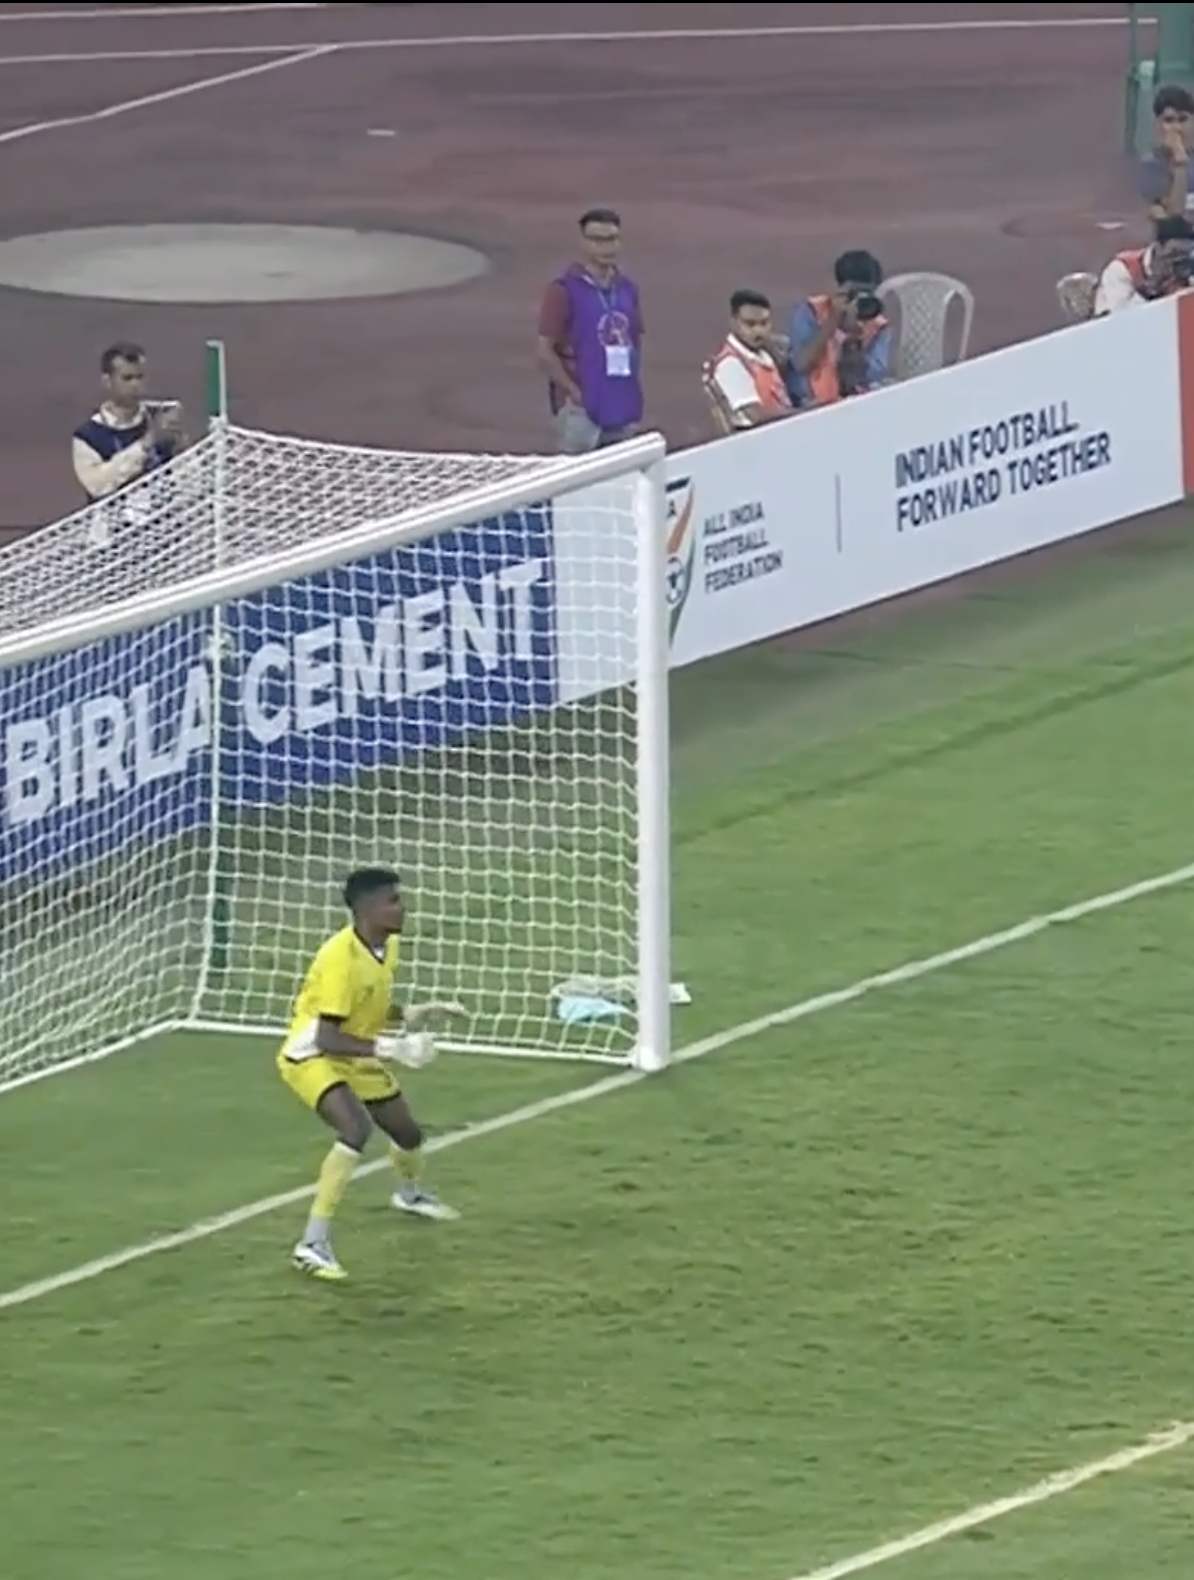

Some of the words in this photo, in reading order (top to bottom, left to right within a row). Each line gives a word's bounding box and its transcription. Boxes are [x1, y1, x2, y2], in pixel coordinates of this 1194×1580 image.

[895, 434, 964, 489] INDIAN
[897, 467, 1001, 532] FORWARD
[1007, 431, 1111, 494] TOGETHER
[704, 512, 727, 538] ALL
[728, 500, 765, 529] INDIA
[704, 526, 769, 566] FOOTBALL
[704, 548, 783, 595] FEDERATION
[5, 664, 211, 824] BIRLA
[240, 557, 549, 744] CEMENT
